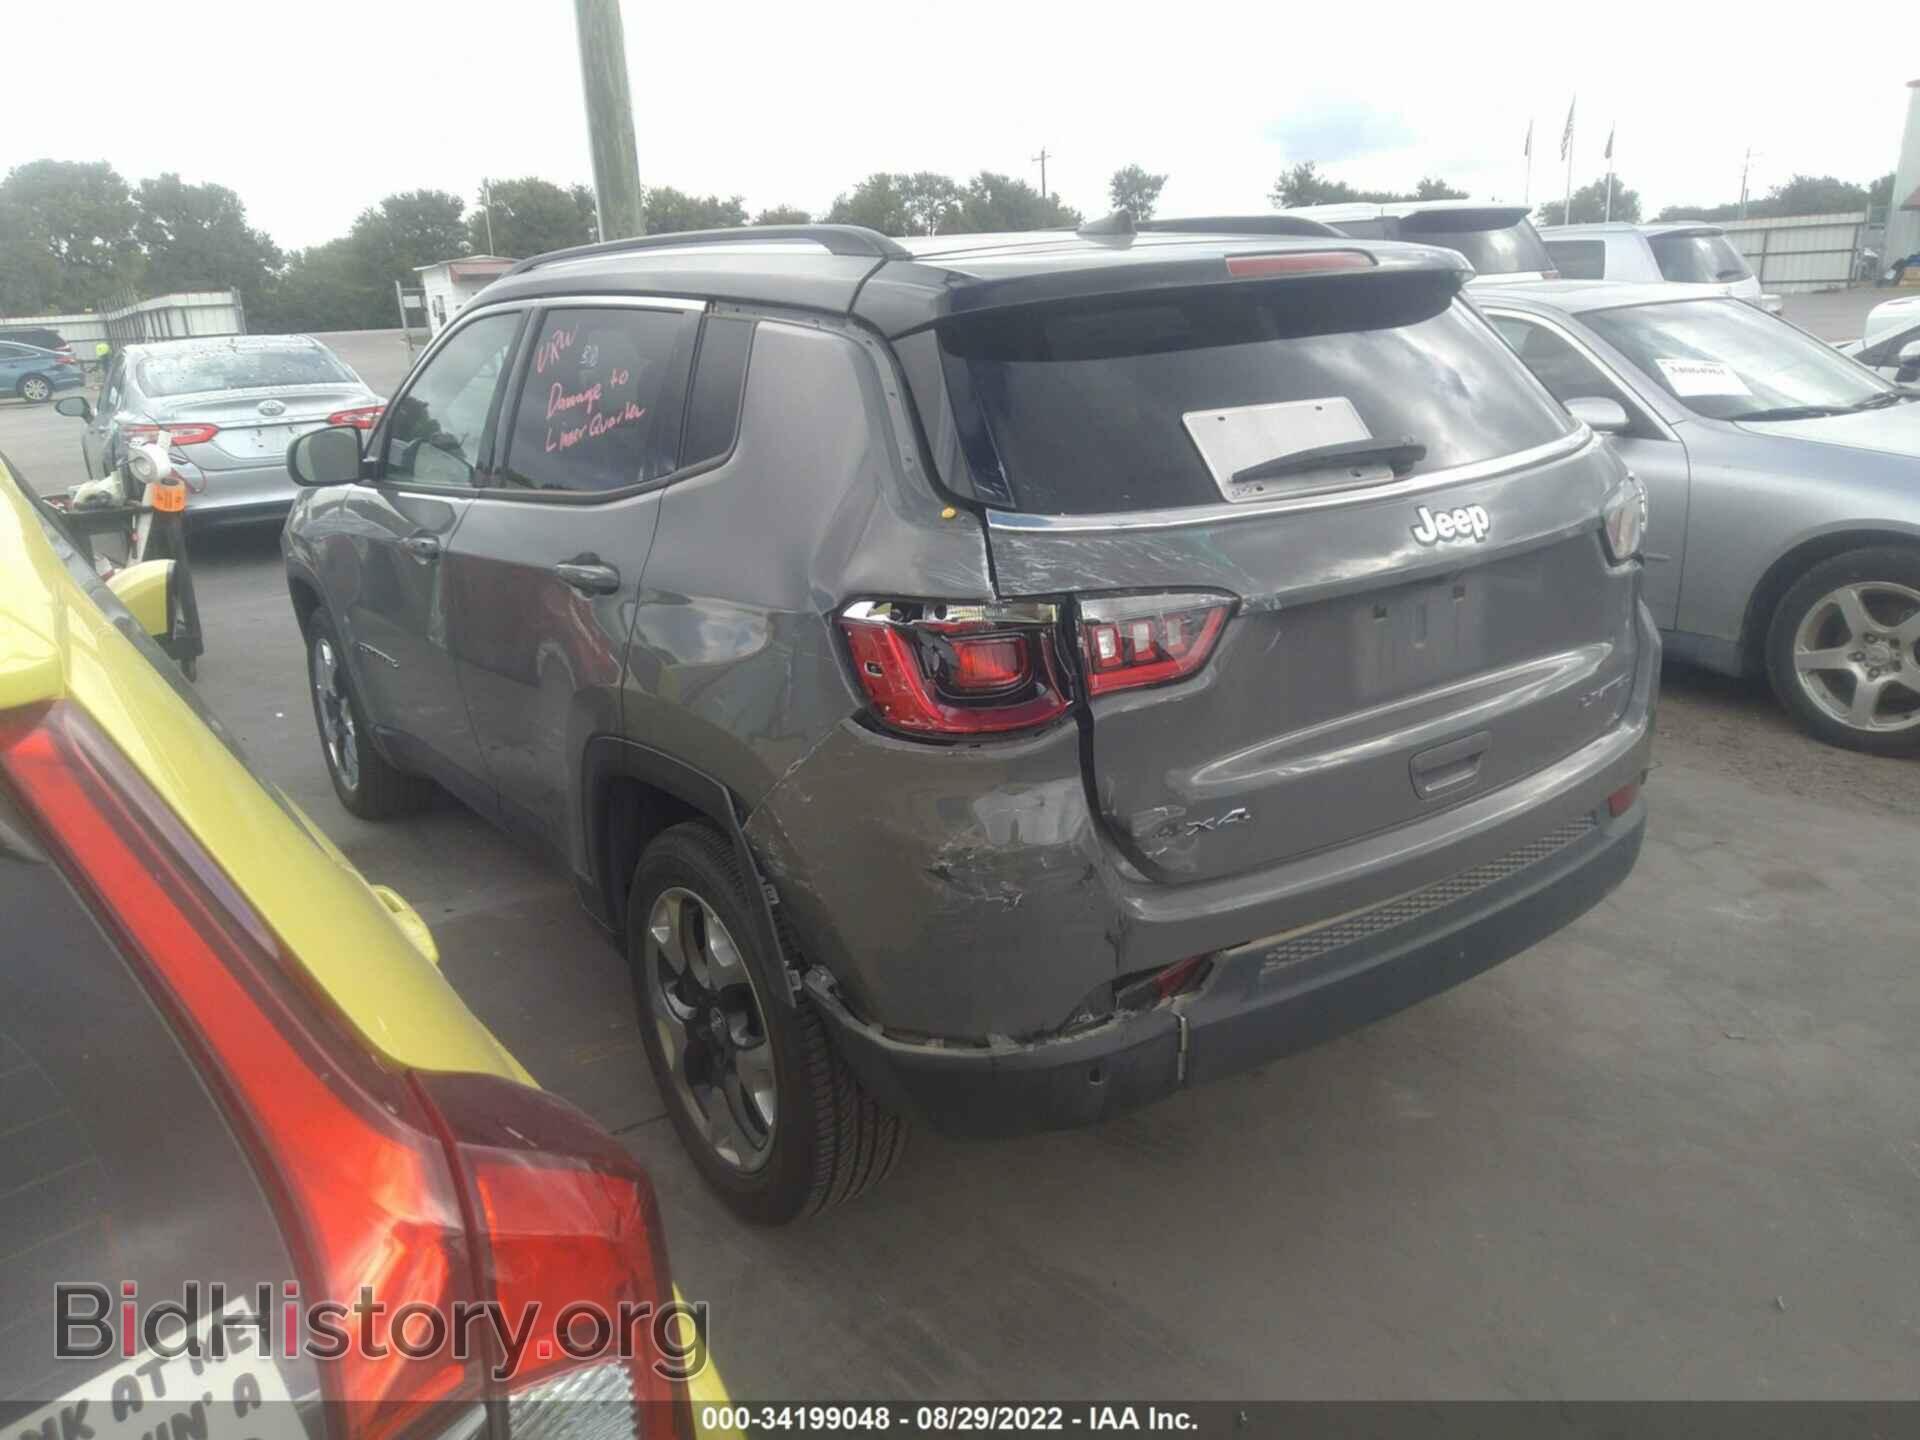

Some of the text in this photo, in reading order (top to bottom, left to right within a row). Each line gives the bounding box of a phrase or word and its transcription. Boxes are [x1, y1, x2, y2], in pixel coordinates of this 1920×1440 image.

[547, 368, 629, 418] Damage to
[589, 402, 646, 436] Quarter
[1411, 504, 1490, 546] Jeep
[111, 1354, 172, 1423] AT
[188, 1309, 254, 1376] ME
[232, 1372, 262, 1418] A
